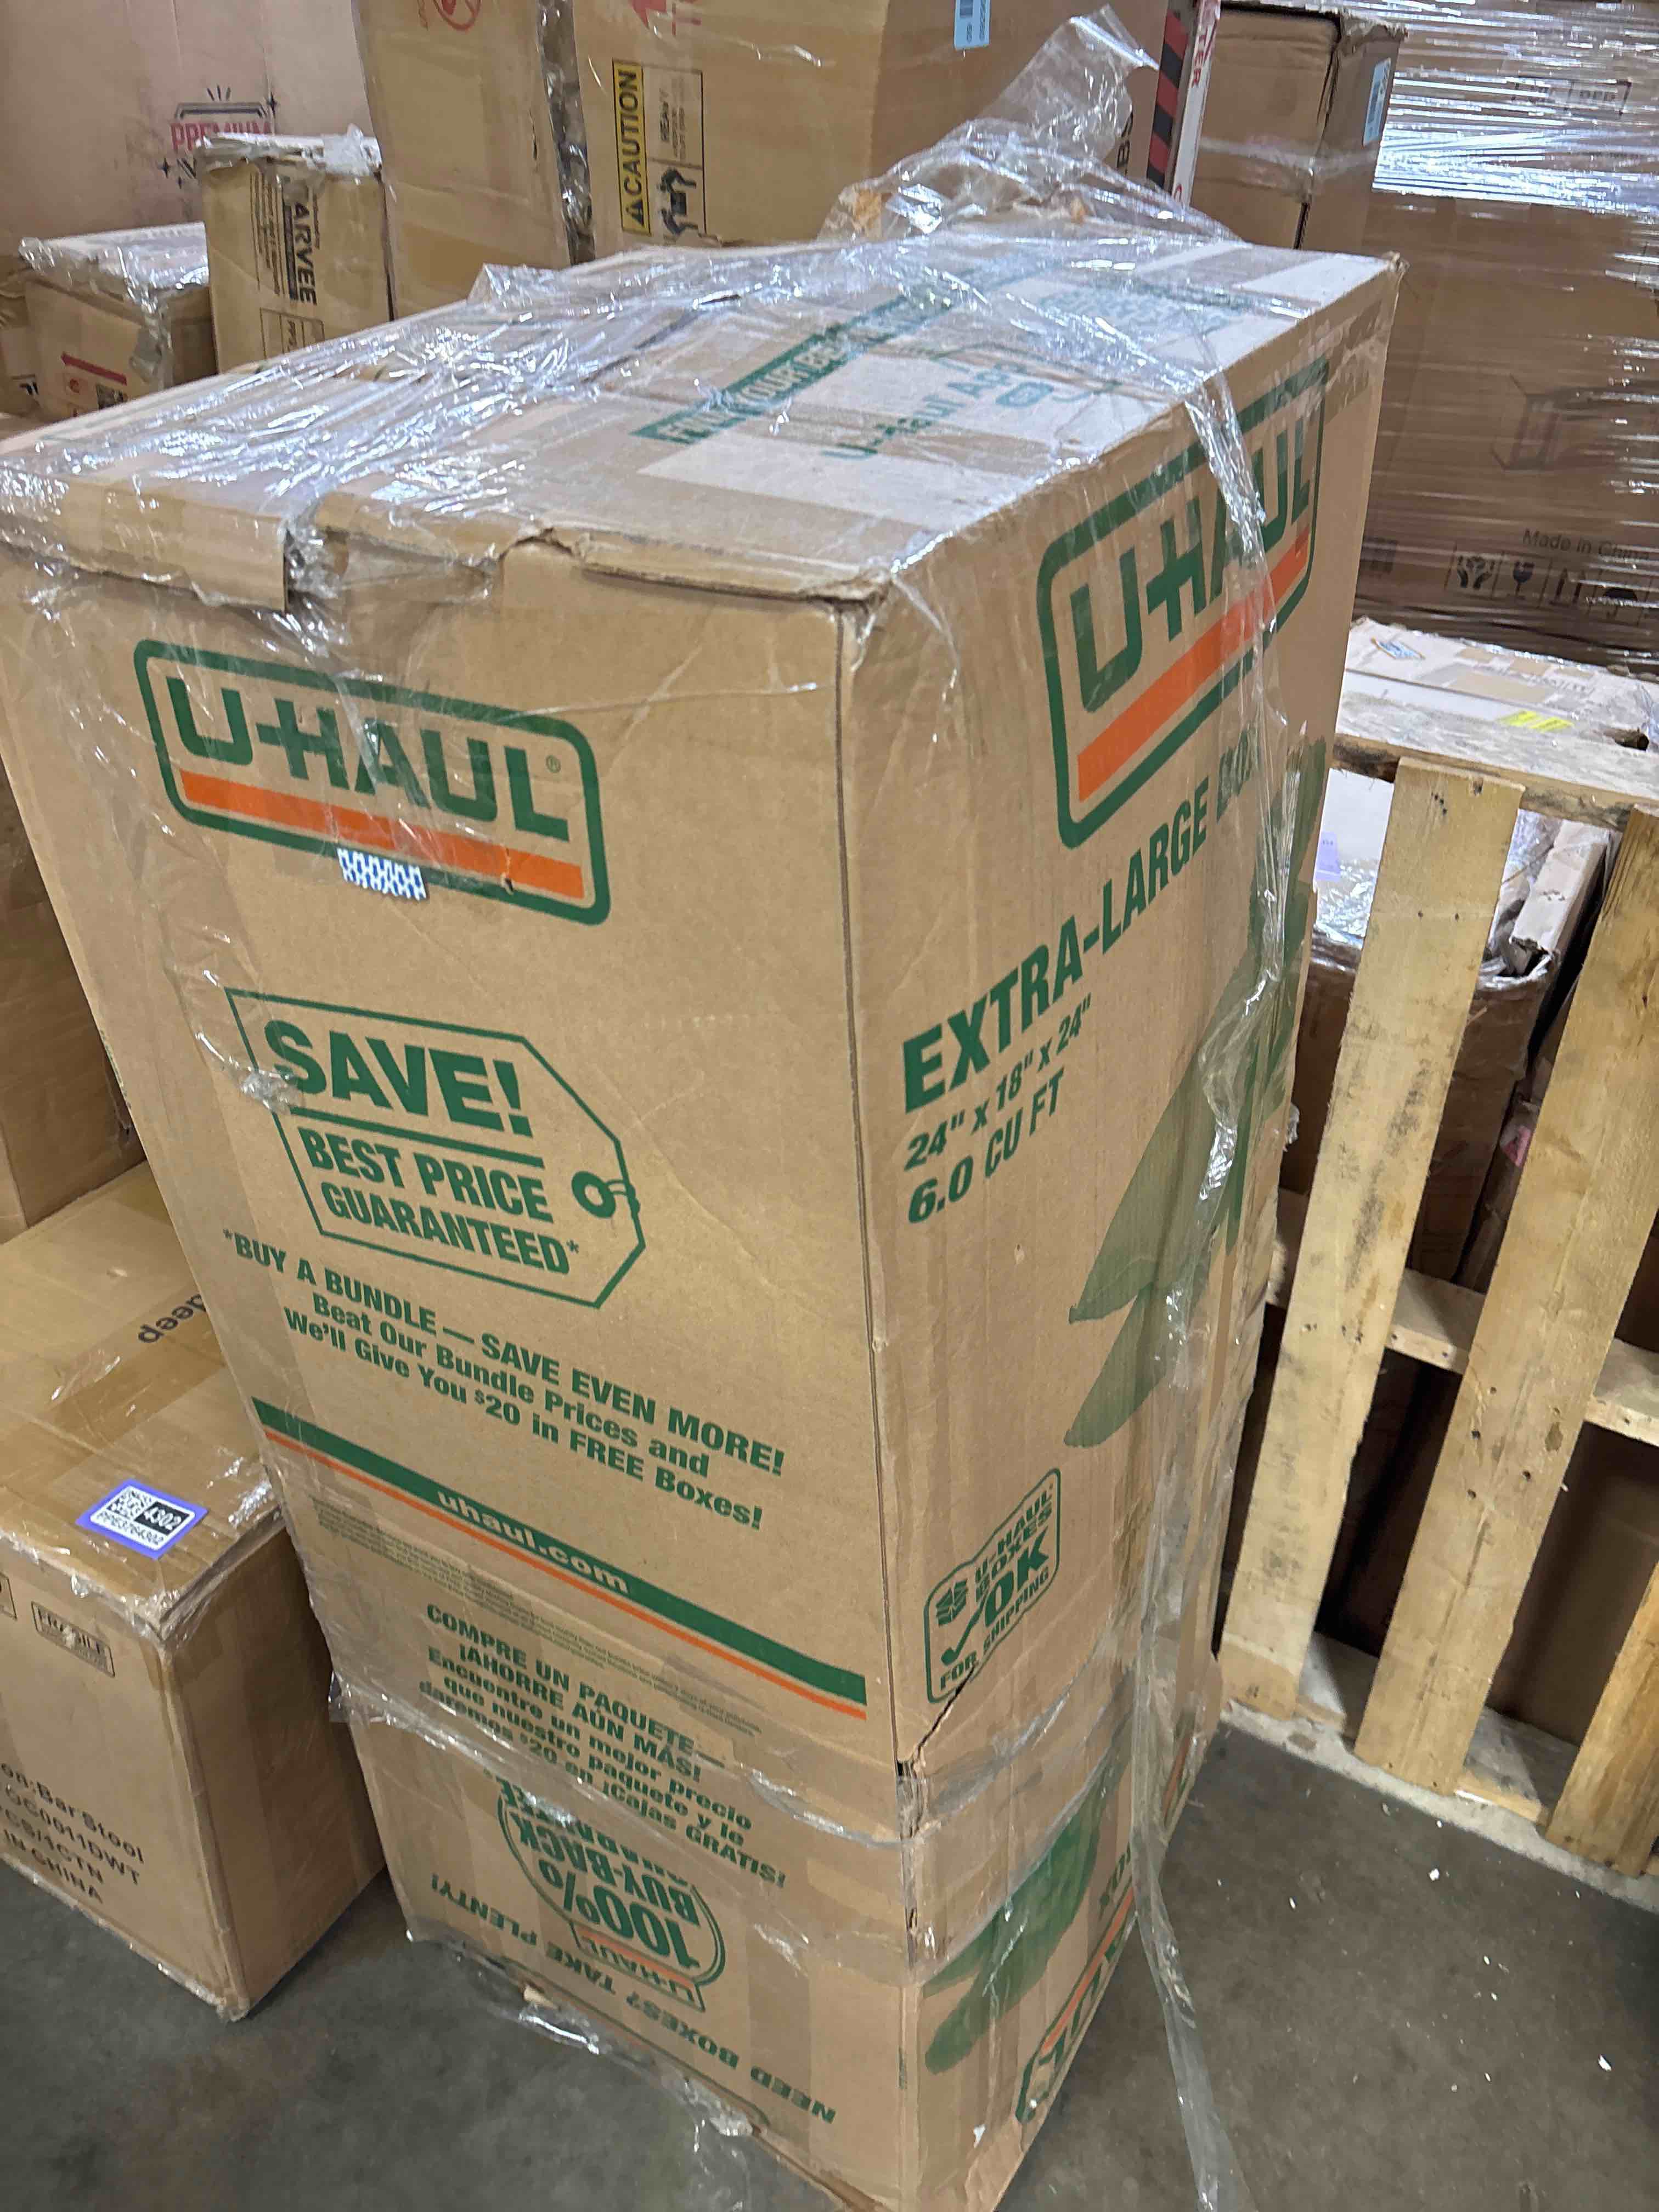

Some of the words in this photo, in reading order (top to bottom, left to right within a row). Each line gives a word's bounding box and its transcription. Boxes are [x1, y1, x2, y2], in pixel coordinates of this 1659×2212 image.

[619, 70, 643, 195] CAUTION
[1522, 528, 1572, 551] Made
[1576, 537, 1592, 554] in
[902, 776, 1209, 1114] EXTRA-LARGE
[264, 1019, 533, 1138] SAVE!
[904, 1110, 965, 1172] 24"
[971, 1097, 989, 1133] x
[995, 1049, 1034, 1112] 18"
[1037, 1042, 1052, 1073] x
[1057, 992, 1092, 1052] 24"
[297, 1126, 405, 1189] BEST
[413, 1152, 554, 1224] PRICE
[907, 1156, 973, 1224] 6.0
[984, 1107, 1020, 1178] CU
[1029, 1066, 1065, 1138] FT
[284, 1307, 347, 1353] We'll
[354, 1336, 411, 1380] Give
[415, 1363, 468, 1407] You
[473, 1387, 521, 1427] $20
[532, 1412, 561, 1444] in
[568, 1430, 644, 1482] FREE
[653, 1464, 763, 1531] Boxes!
[296, 1259, 318, 1286] A
[571, 1365, 656, 1425] EVEN
[668, 1407, 785, 1476] MORE!
[312, 1293, 373, 1336] Beat
[379, 1320, 430, 1358] Our
[437, 1341, 535, 1405] Bundle
[544, 1386, 639, 1450] Prices
[648, 1438, 710, 1479] and
[437, 1489, 630, 1596] uhaul.com
[977, 1502, 1052, 1602] BOXES
[985, 1526, 1048, 1628] OK
[427, 1604, 527, 1670] COMPRE
[535, 1660, 571, 1692] UN
[940, 1650, 977, 1691] FOR
[984, 1566, 1049, 1655] SHIPPING
[428, 1646, 544, 1720] Encuentre
[551, 1714, 581, 1741] un
[589, 1734, 662, 1783] mejor
[668, 1779, 753, 1831] precio
[444, 1677, 484, 1707] que
[493, 1702, 580, 1758] nuestro
[589, 1755, 690, 1817] paquete
[698, 1811, 712, 1830] y
[720, 1822, 744, 1847] le
[572, 1700, 624, 1742] AÚN
[509, 1809, 701, 1928] BUY-BACK
[566, 1761, 594, 1785] en
[686, 1823, 786, 1889] GRATIS!
[431, 1872, 539, 1947] PLENTY!
[541, 1858, 701, 1972] 100%
[547, 1944, 617, 1996] TAKE
[626, 1989, 740, 2070] BOXES?
[748, 2066, 837, 2125] NEED
